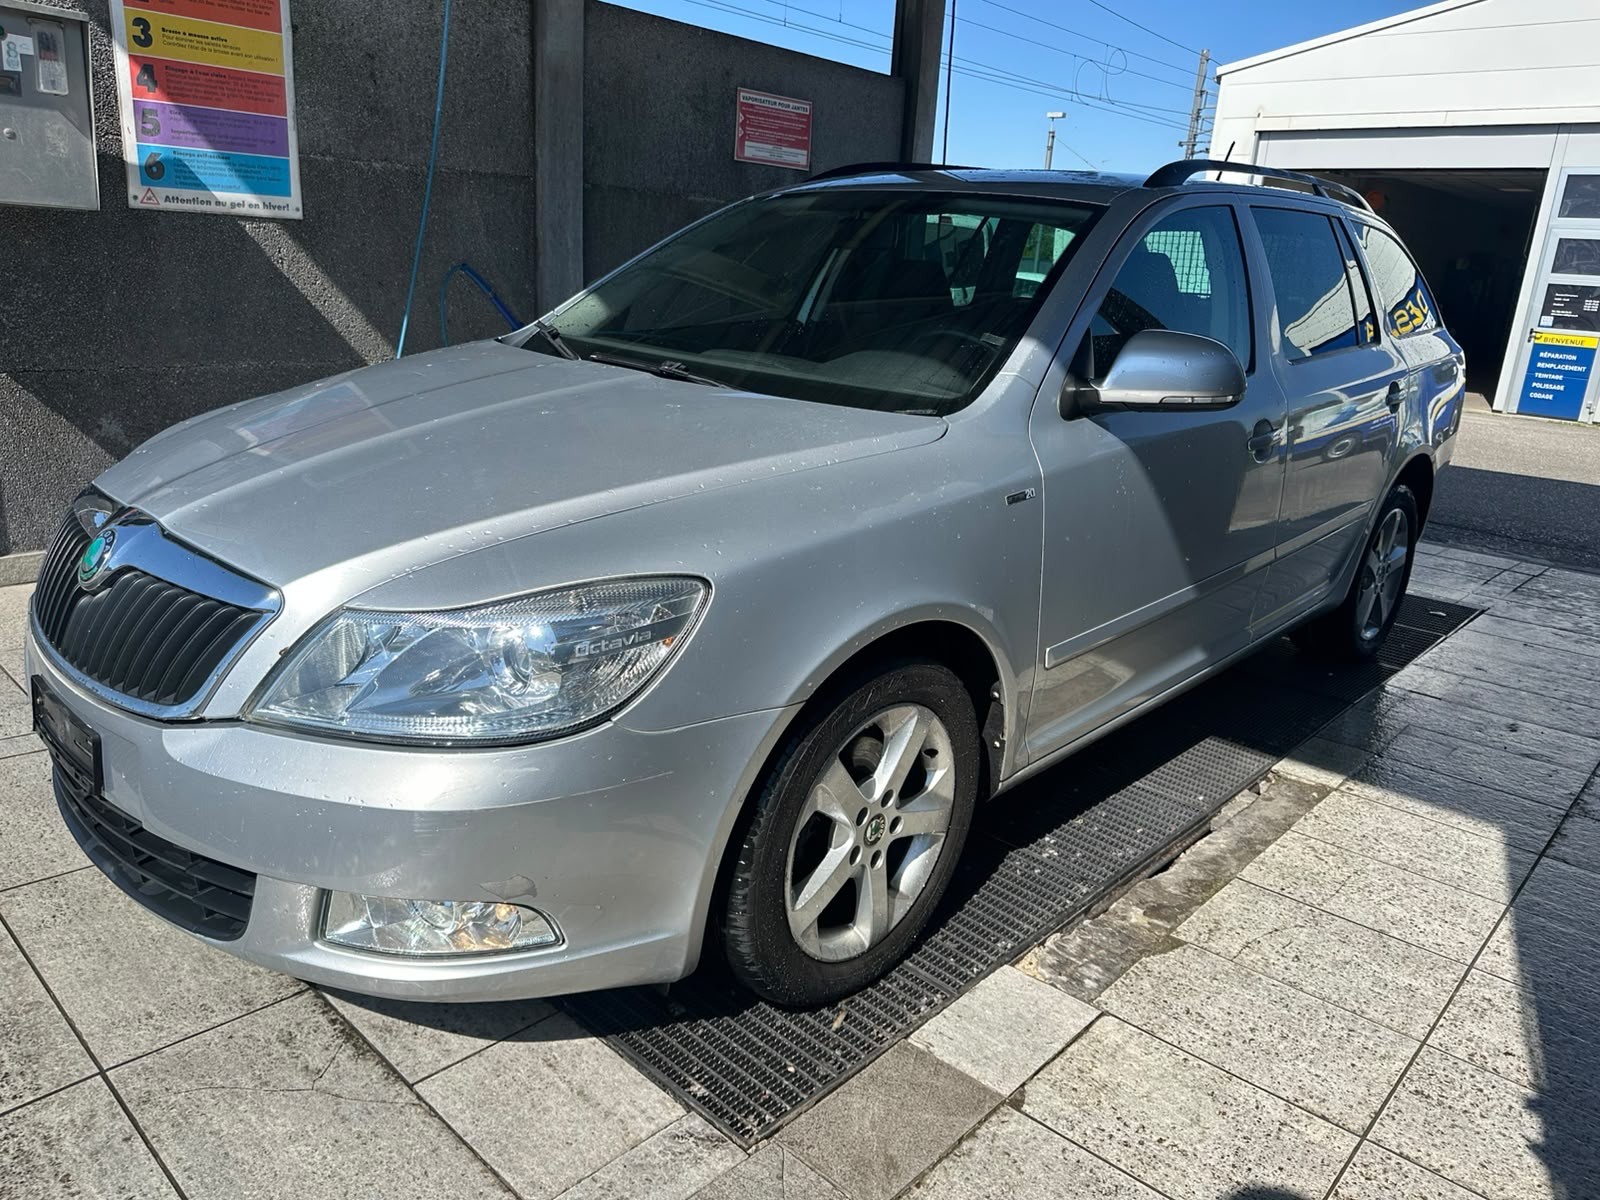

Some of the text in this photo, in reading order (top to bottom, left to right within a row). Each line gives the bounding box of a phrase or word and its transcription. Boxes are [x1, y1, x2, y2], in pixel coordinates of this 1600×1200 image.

[132, 17, 153, 48] 3
[136, 64, 158, 93] 4
[742, 95, 777, 106] VAPORISATEUR
[791, 104, 808, 113] JANTES
[141, 108, 161, 137] 5
[144, 152, 165, 181] 6
[163, 195, 212, 206] Attention
[230, 200, 245, 209] gel
[263, 202, 289, 211] hiver!
[1543, 336, 1585, 346] BIENVENUE
[1539, 351, 1577, 360] RÉPARATION
[1536, 362, 1587, 372] REMPLACEMENT
[1535, 372, 1564, 380] TEINTAGE
[1532, 382, 1565, 391] POLISSAGE
[574, 630, 652, 657] Octavia
